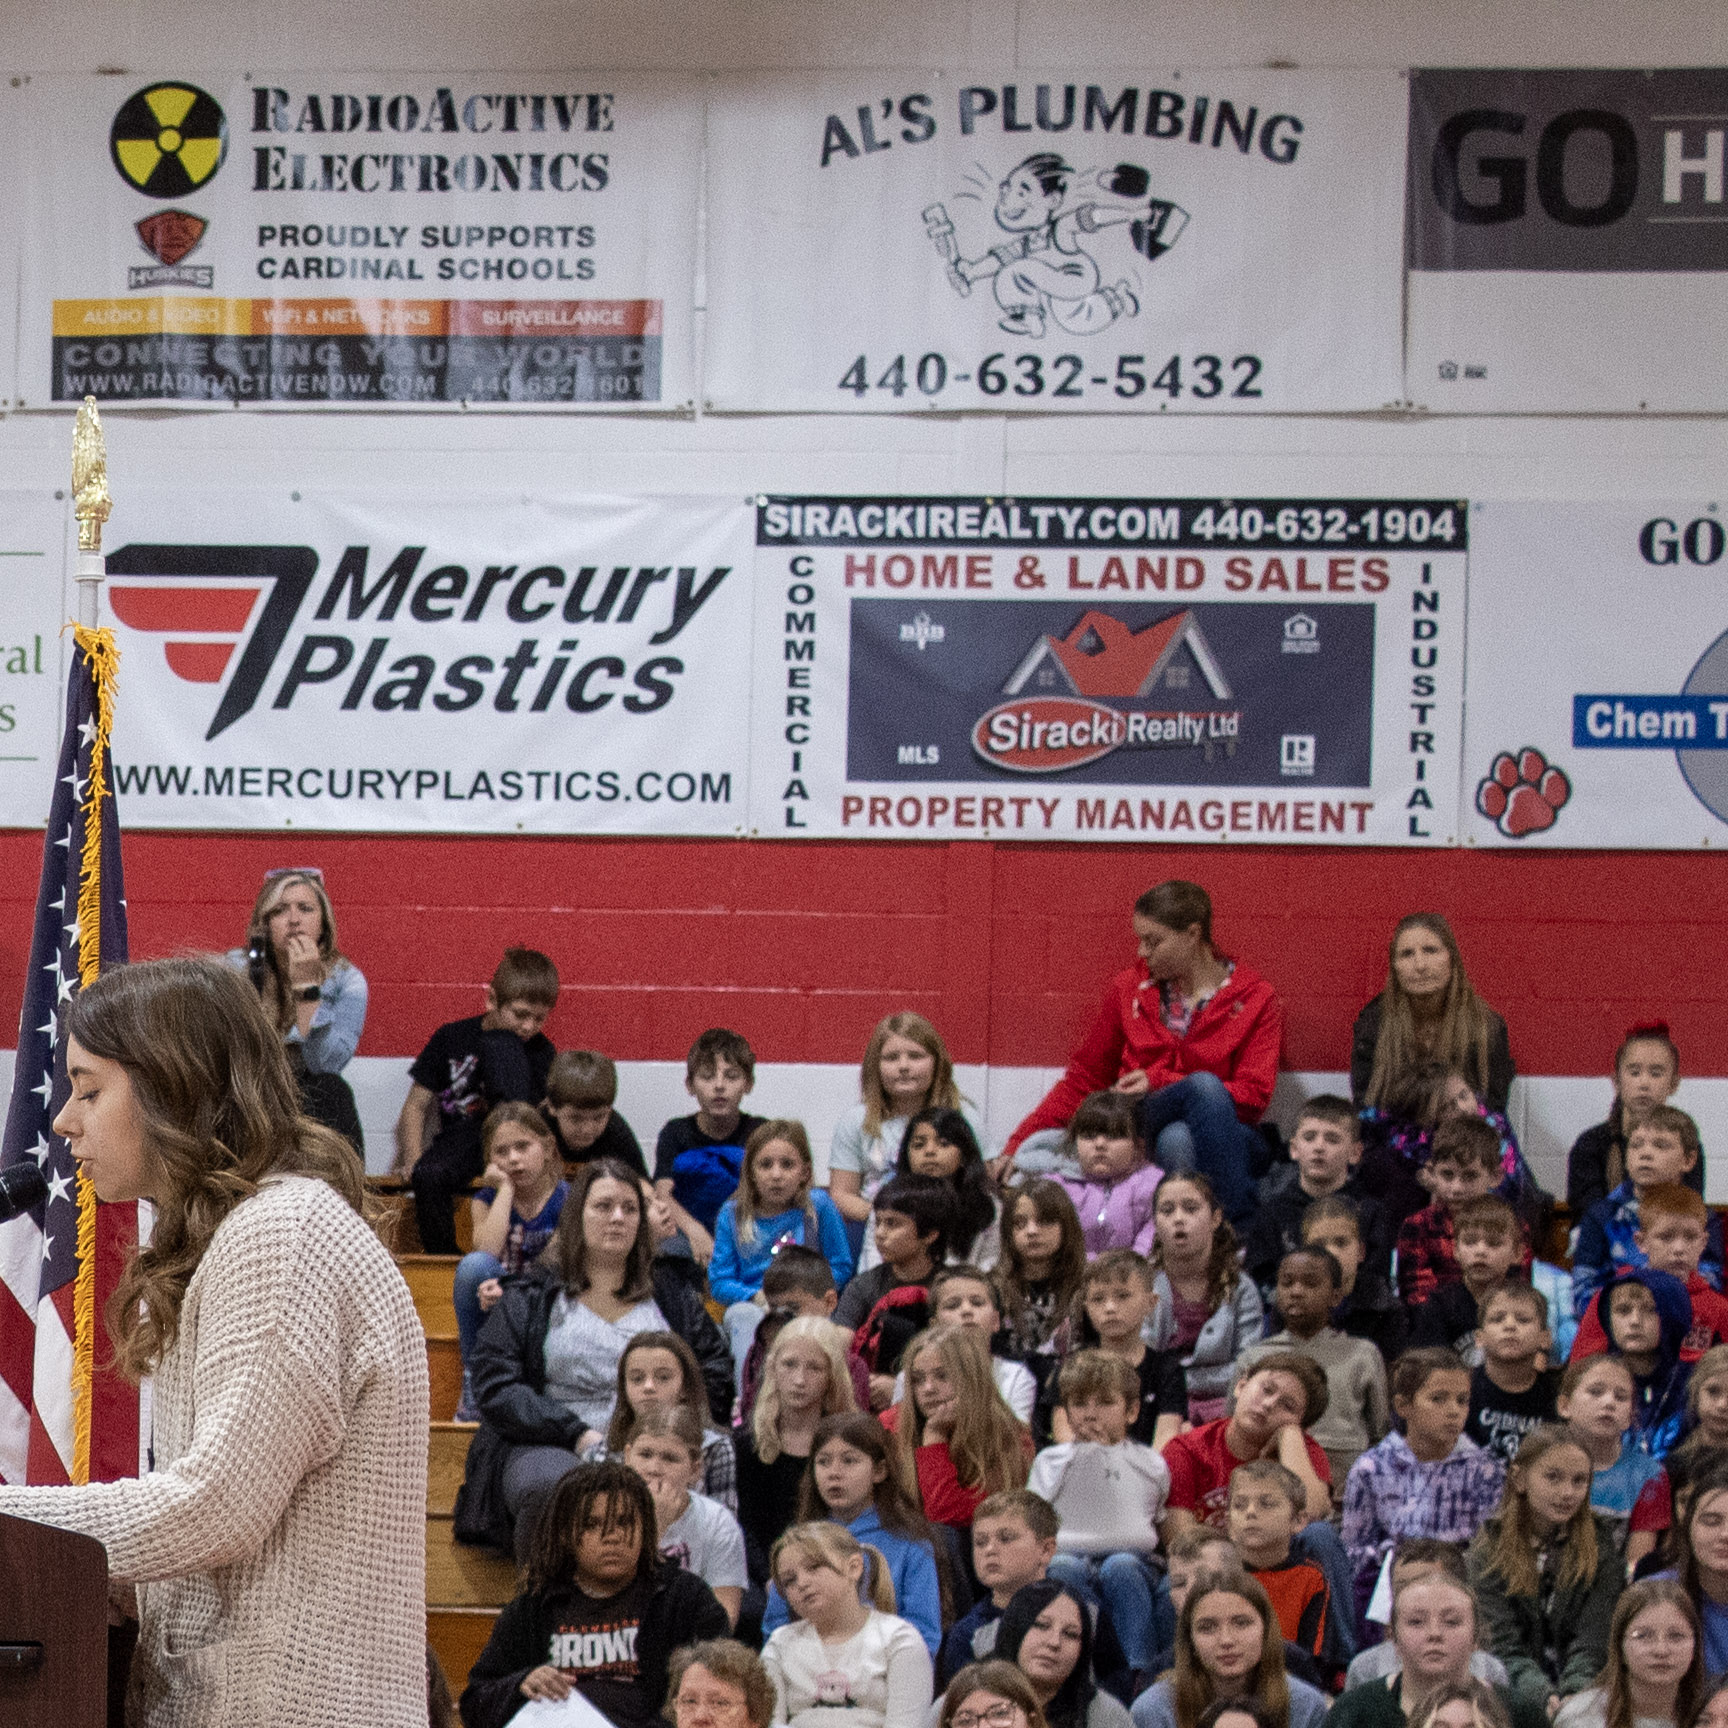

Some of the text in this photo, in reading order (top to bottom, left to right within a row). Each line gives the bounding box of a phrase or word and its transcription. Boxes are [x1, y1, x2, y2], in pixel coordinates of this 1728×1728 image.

[957, 82, 1307, 167] PLUMBING
[1431, 107, 1640, 228] GO
[257, 225, 597, 251] PROUDLY SUPPORTS
[257, 257, 597, 283] CARDINAL SCHOOLS
[481, 309, 625, 327] SURVEILLANCE
[63, 342, 343, 368] CONNECTING
[836, 352, 1266, 401] 440-632-5432
[762, 507, 1457, 543] SIRACKIREALTY.COM 440-632-1904
[1638, 517, 1727, 567] GO
[844, 554, 1392, 593] HOME & LAND SALES
[314, 545, 733, 645] Mercury
[272, 634, 686, 714] Plastics
[782, 555, 816, 829] COMMERCIAL
[1409, 562, 1440, 839] INDUSTRIAL
[1585, 701, 1696, 740] Chem
[987, 711, 1240, 752] Siracki Realty Ltd
[897, 745, 941, 765] MLS
[114, 764, 733, 804] WW.MERCURYPLASTICS.COM
[841, 795, 1375, 835] PROPERTY MANAGEMENT
